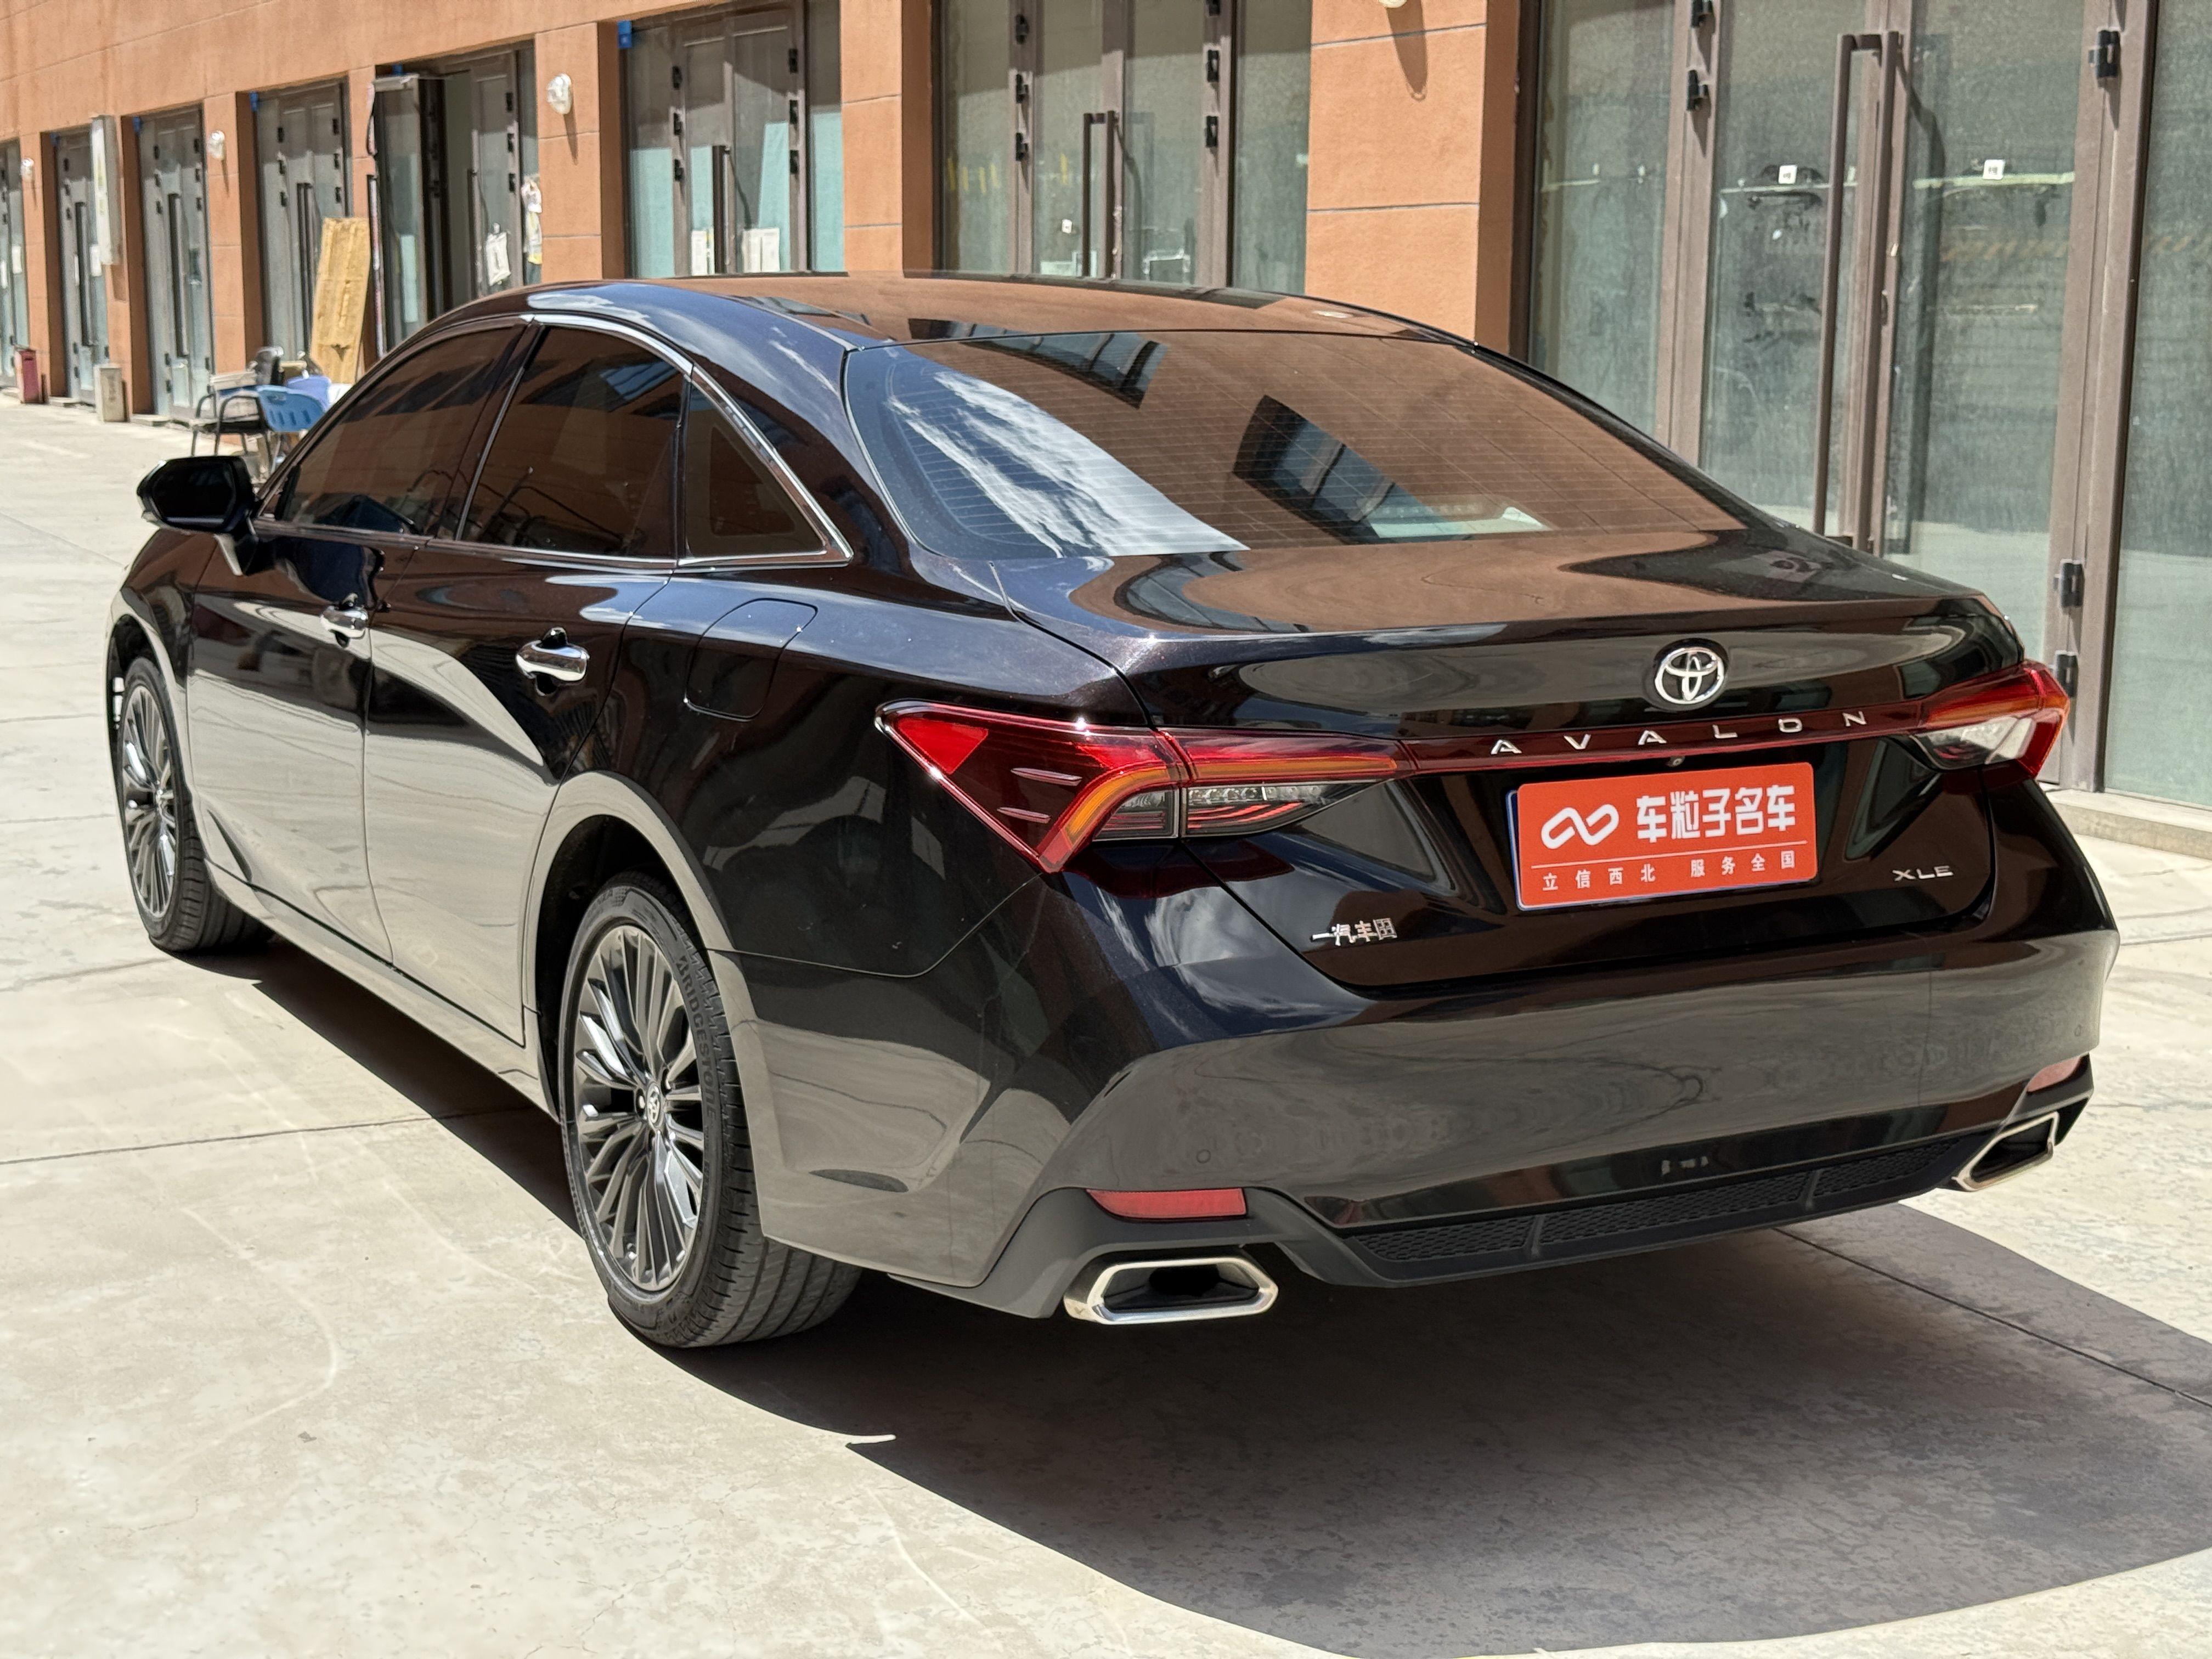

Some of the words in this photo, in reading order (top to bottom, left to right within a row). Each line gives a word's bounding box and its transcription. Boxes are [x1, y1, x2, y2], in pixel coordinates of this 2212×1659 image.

[1490, 711, 1866, 755] AVALON
[1636, 785, 1796, 843] 车粒子名车
[1542, 864, 1656, 891] 立信西北
[1691, 850, 1796, 878] 服务全国
[1893, 865, 1954, 882] XLE
[1312, 917, 1398, 946] 一汽丰田
[676, 955, 717, 1121] BRIDGESTONE
